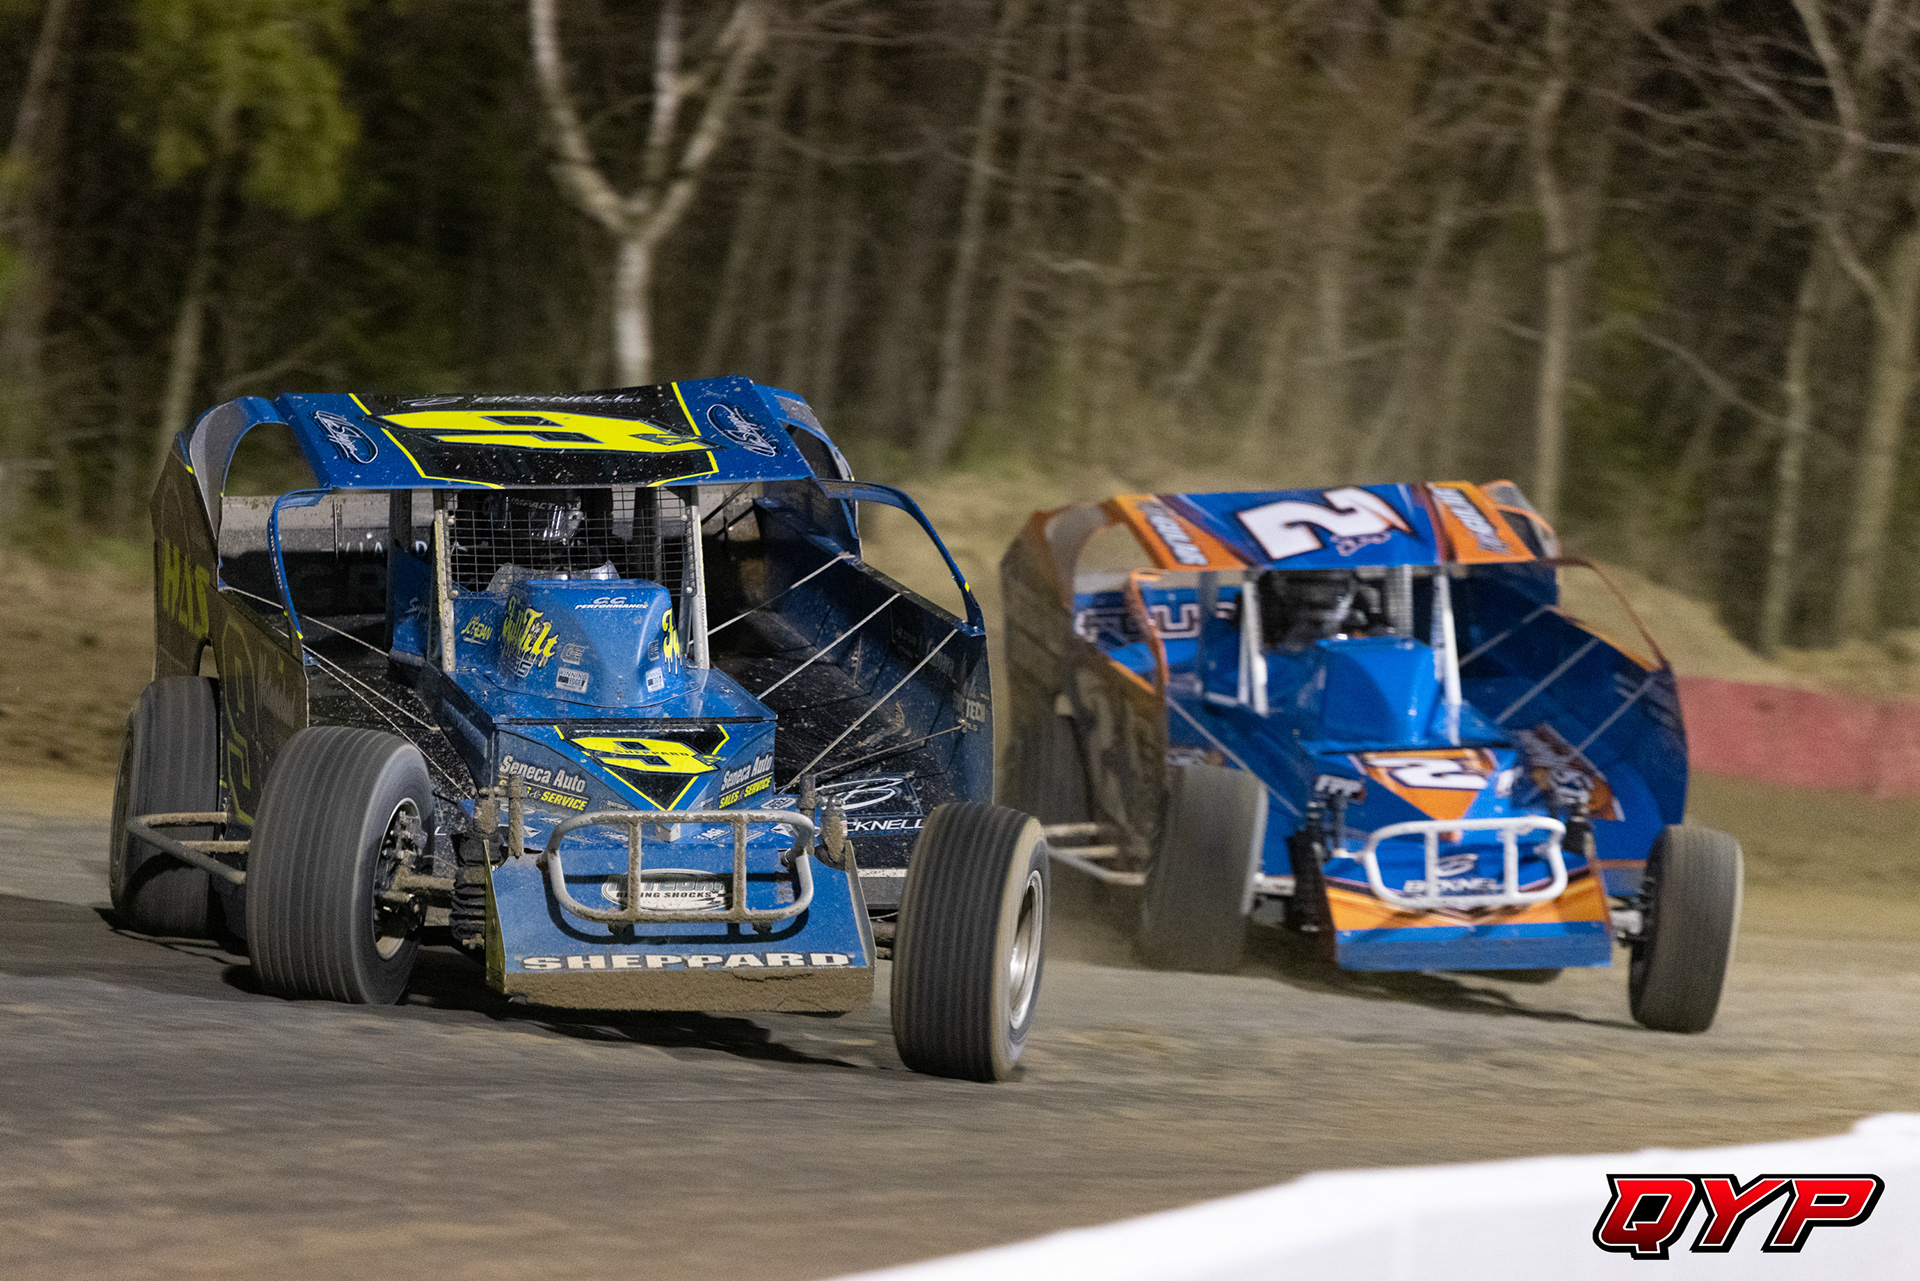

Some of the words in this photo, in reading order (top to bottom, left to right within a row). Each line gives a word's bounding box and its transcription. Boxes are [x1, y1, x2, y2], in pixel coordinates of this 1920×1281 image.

[1238, 487, 1411, 560] 2
[575, 602, 649, 610] PERFORMANCE
[499, 755, 552, 784] Seneca
[553, 769, 587, 793] Auto
[720, 764, 752, 791] Seneca
[750, 753, 774, 777] Auto
[540, 791, 588, 811] SERVICE
[718, 790, 740, 809] SALES
[743, 776, 772, 797] SERVICE
[842, 818, 926, 832] CKNELL
[663, 891, 713, 899] SHOCKS
[521, 953, 852, 970] SHEPPARD
